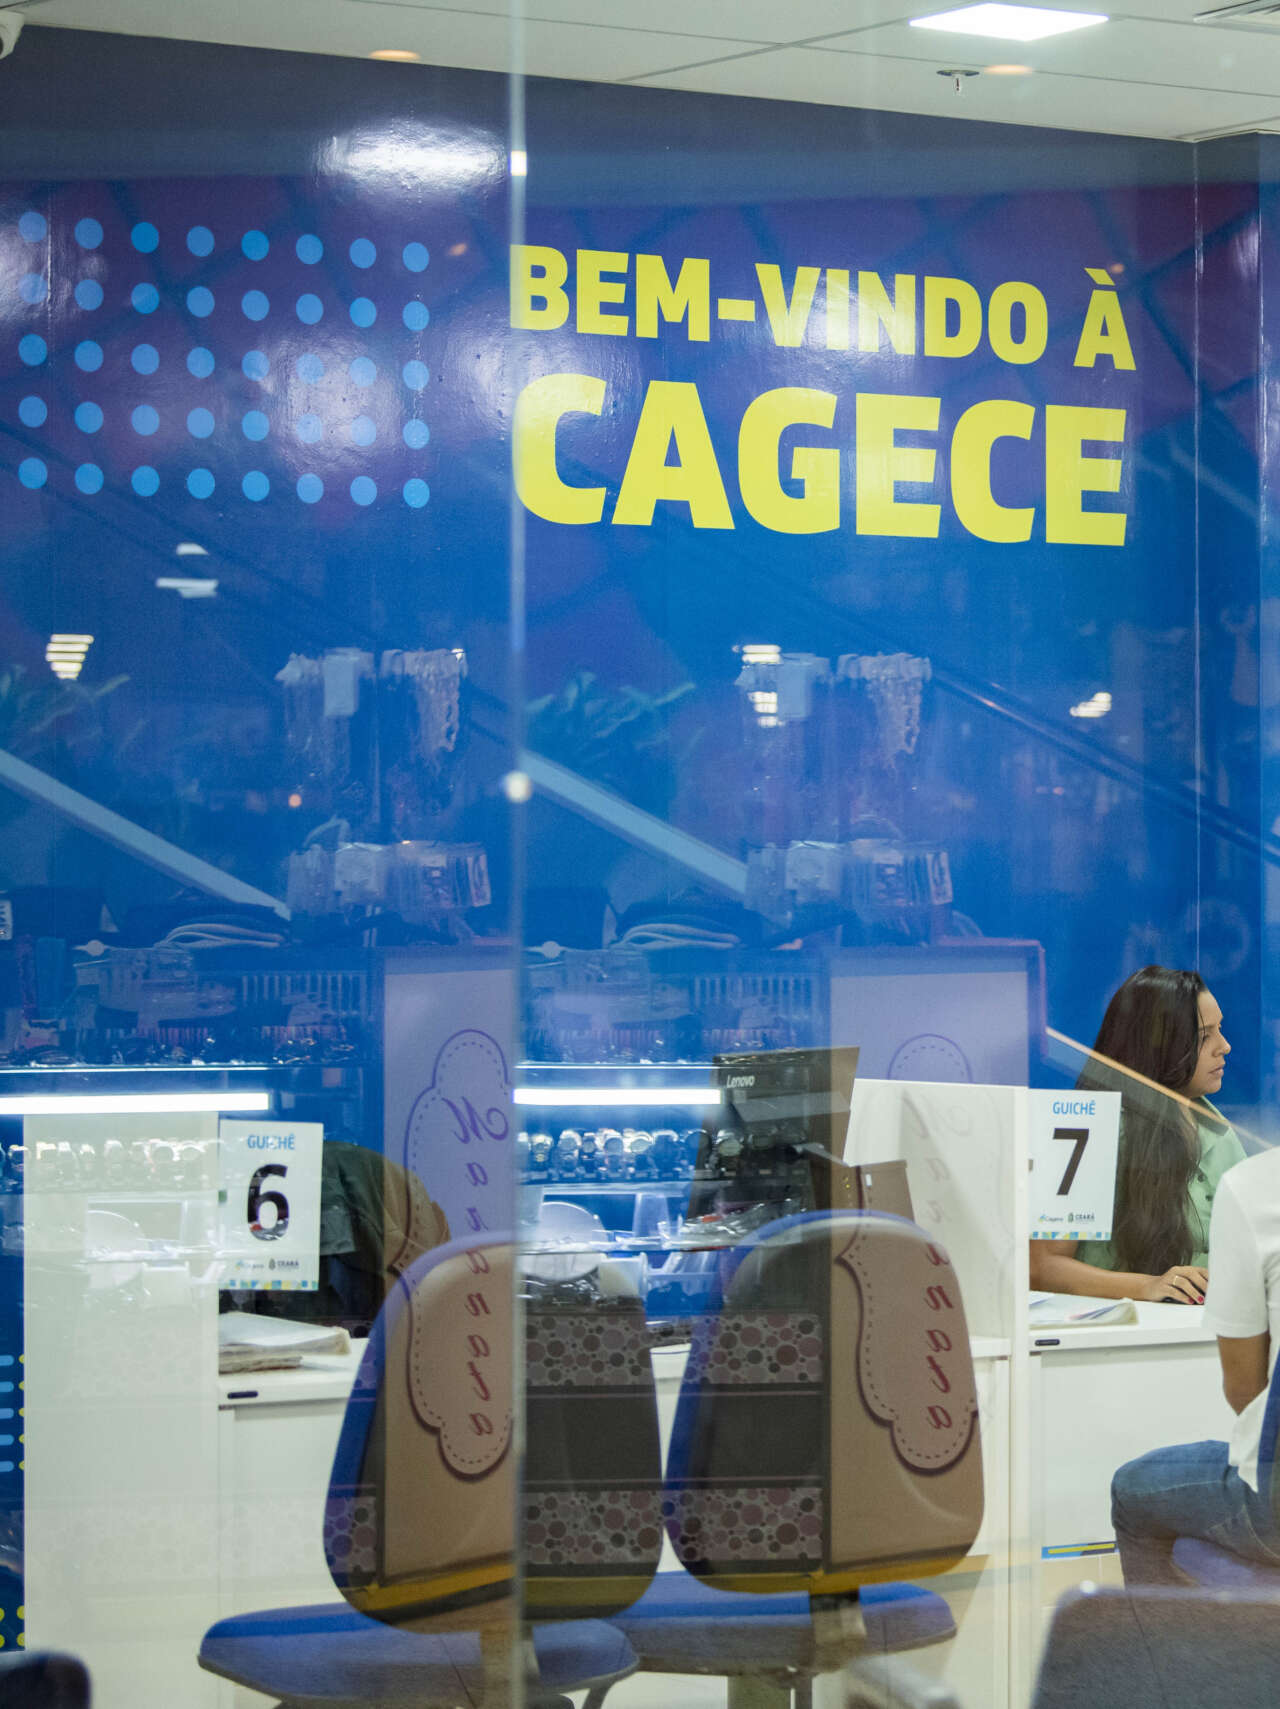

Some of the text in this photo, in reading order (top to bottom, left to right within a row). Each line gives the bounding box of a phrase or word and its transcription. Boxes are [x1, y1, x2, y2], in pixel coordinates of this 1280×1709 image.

[510, 244, 1137, 372] BEM-VINDO À
[512, 373, 1128, 546] CAGECE
[726, 1074, 756, 1088] Lenovo
[1052, 1100, 1097, 1116] GUICHÊ
[1052, 1127, 1090, 1196] 7
[247, 1163, 290, 1242] 6
